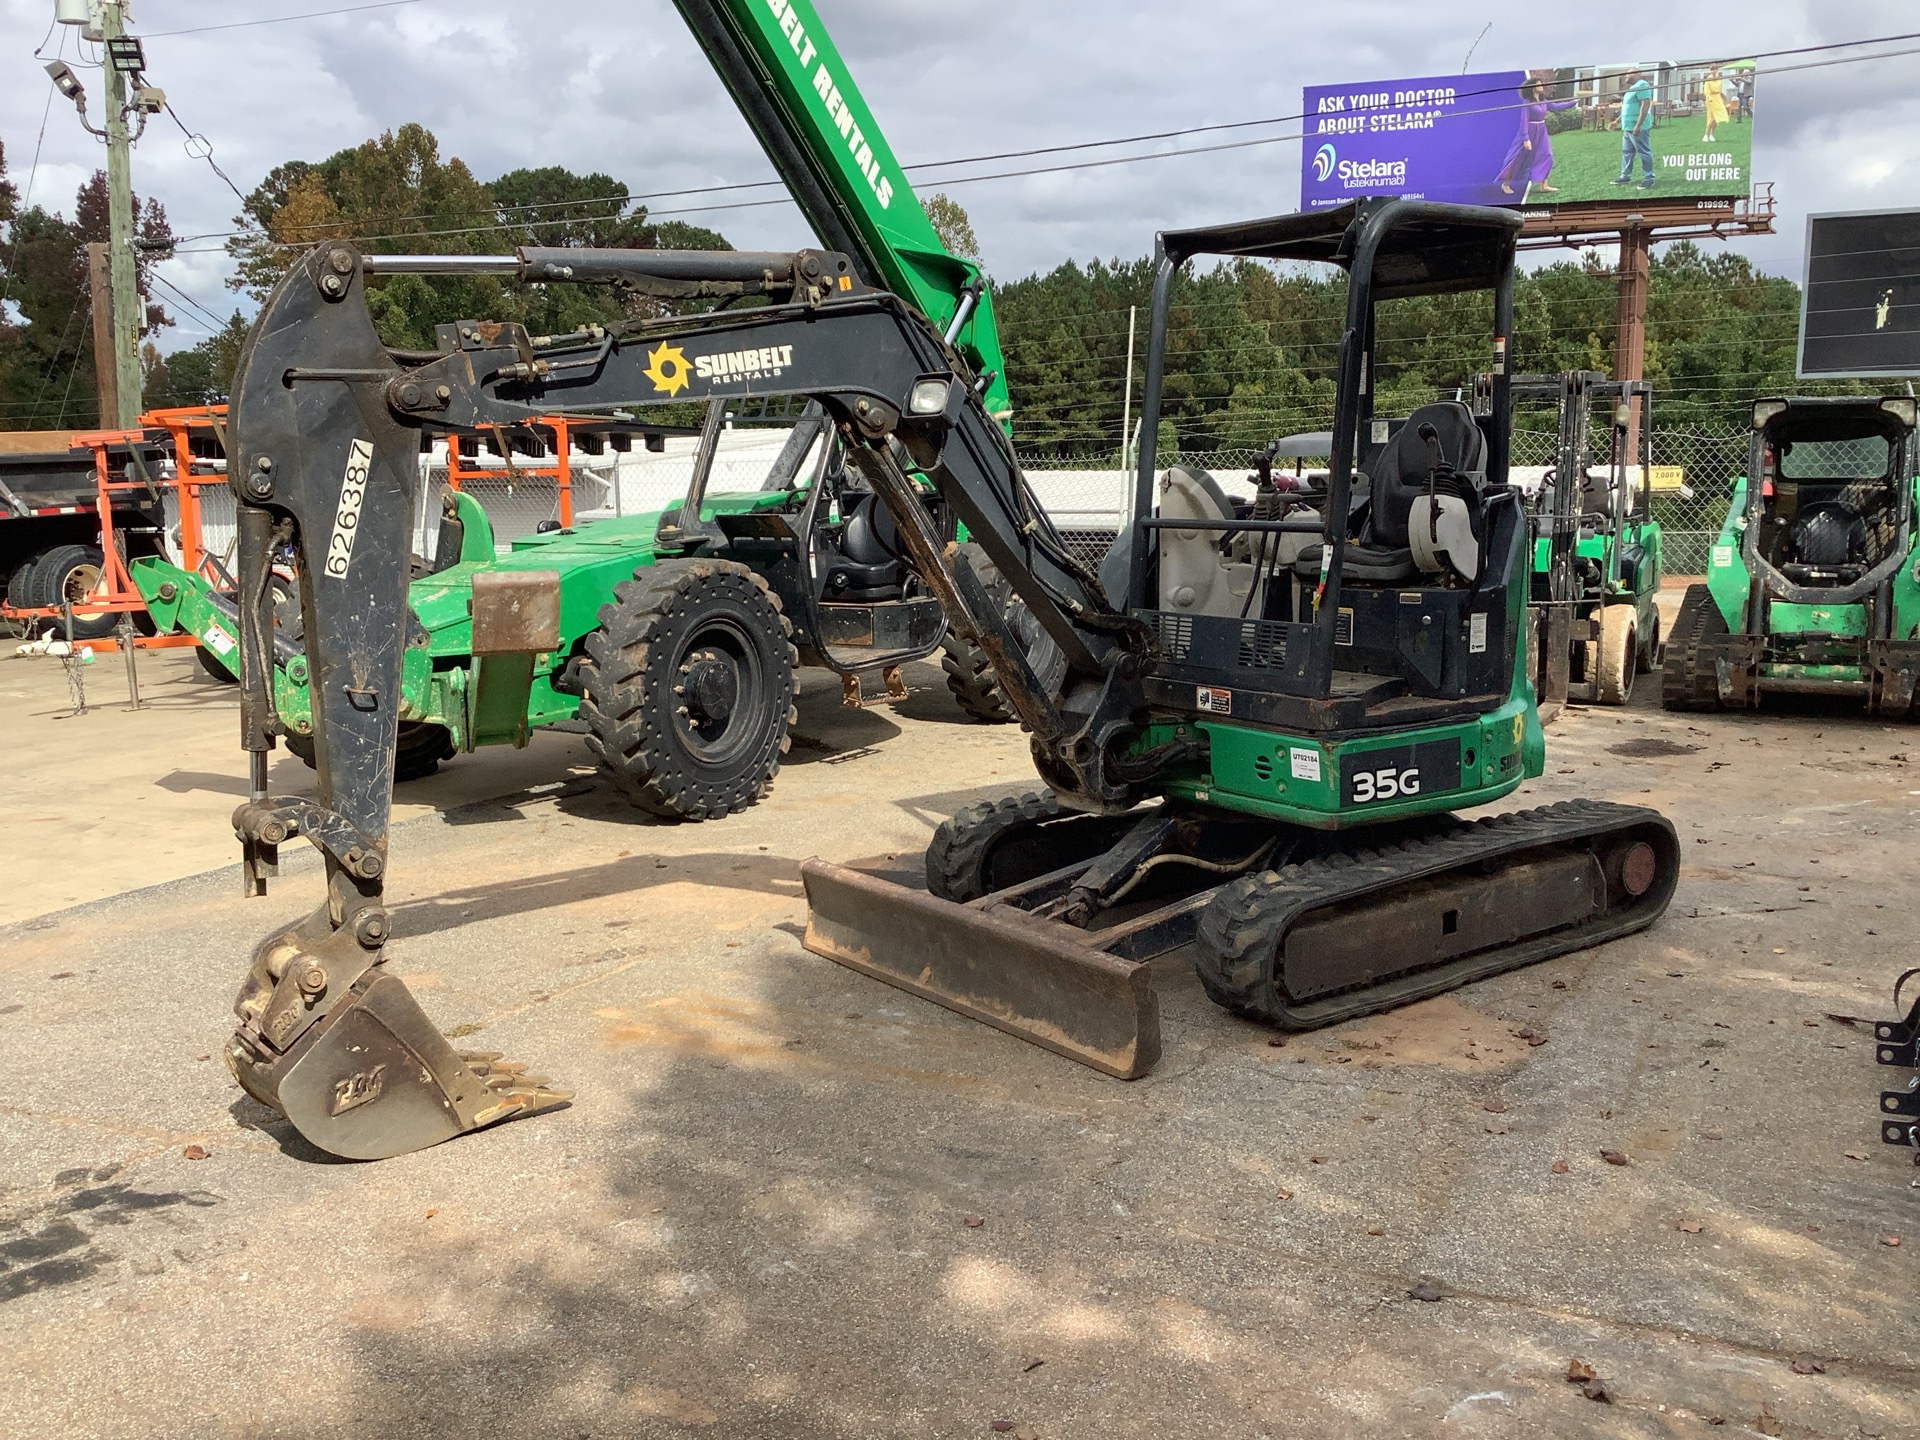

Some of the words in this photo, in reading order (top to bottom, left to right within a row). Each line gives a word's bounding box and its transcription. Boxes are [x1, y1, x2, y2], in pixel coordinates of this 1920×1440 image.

[1317, 96, 1345, 114] ASK
[1350, 92, 1389, 111] YOUR
[1395, 88, 1455, 109] DOCTOR
[812, 62, 893, 210] RENTALS
[1317, 116, 1366, 135] ABOUT
[1662, 154, 1685, 167] YOU
[1688, 153, 1732, 166] BELONG
[1686, 168, 1708, 181] OUT
[1711, 167, 1740, 180] HERE
[694, 345, 793, 377] SUNBELT
[712, 368, 782, 385] RENTALS
[328, 441, 370, 575] 626387
[1352, 768, 1420, 803] 35G
